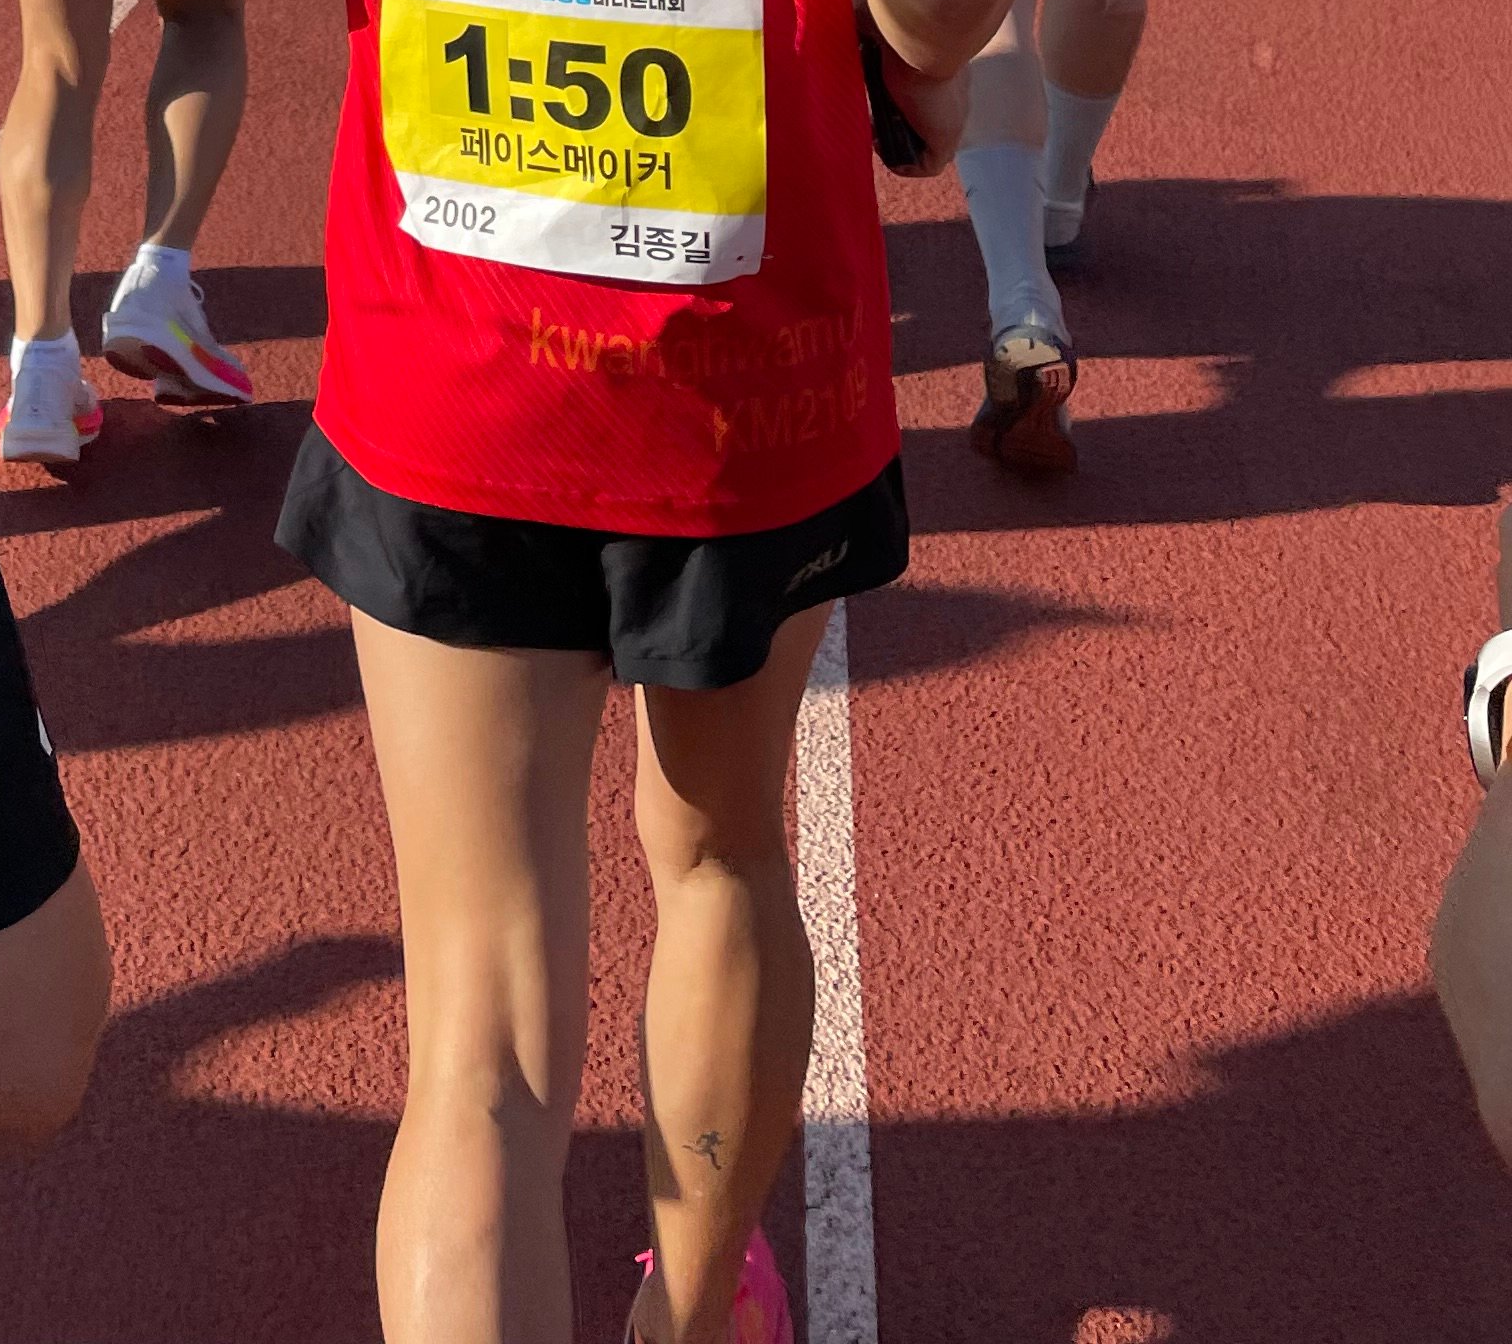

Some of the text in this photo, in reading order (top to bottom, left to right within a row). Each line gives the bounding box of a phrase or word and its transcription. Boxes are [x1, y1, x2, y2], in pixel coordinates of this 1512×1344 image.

[444, 23, 692, 138] 1:50
[460, 127, 672, 190] 페이스메이커
[424, 195, 497, 235] 2002
[610, 224, 712, 264] 김종길
